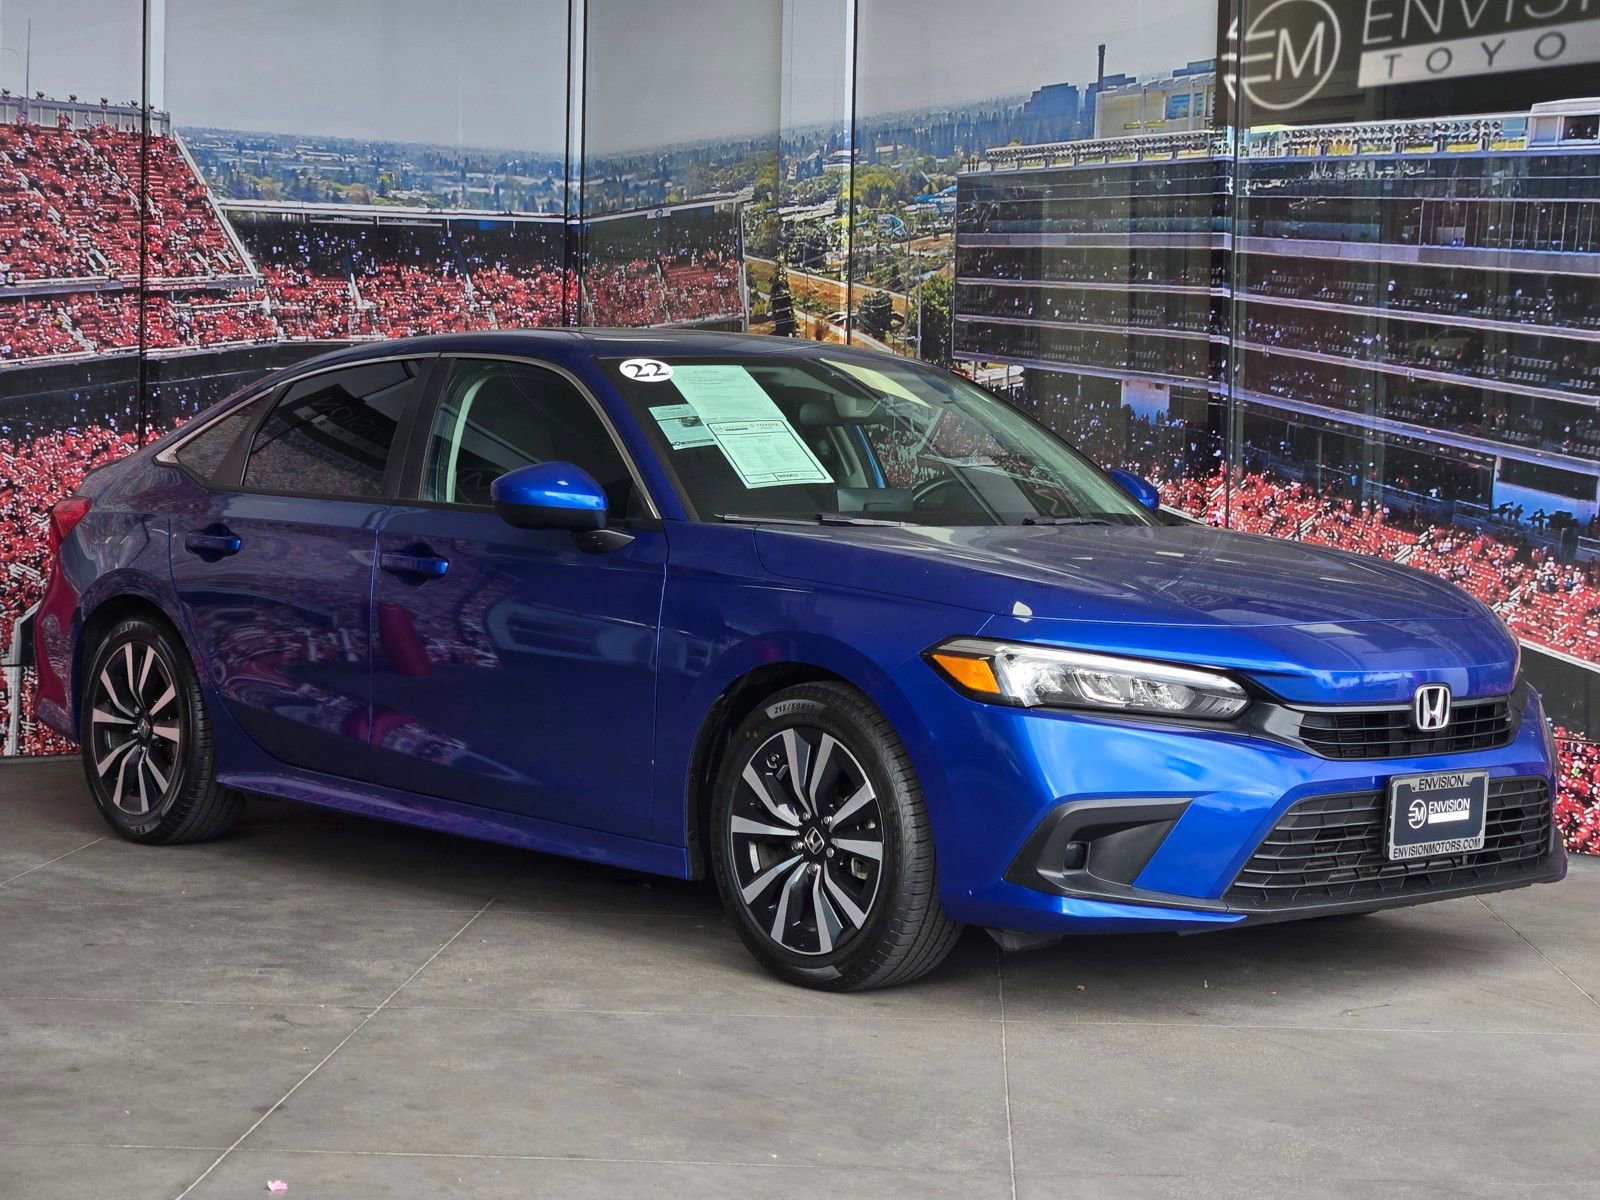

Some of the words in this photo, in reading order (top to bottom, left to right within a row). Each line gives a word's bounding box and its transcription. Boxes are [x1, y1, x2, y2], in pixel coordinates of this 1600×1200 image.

[1362, 0, 1589, 45] ENV
[625, 362, 669, 378] 22
[1418, 774, 1465, 791] ENVISION
[1428, 797, 1471, 814] ENVISION
[1393, 838, 1481, 858] ENVISIONMOTORS.COM
